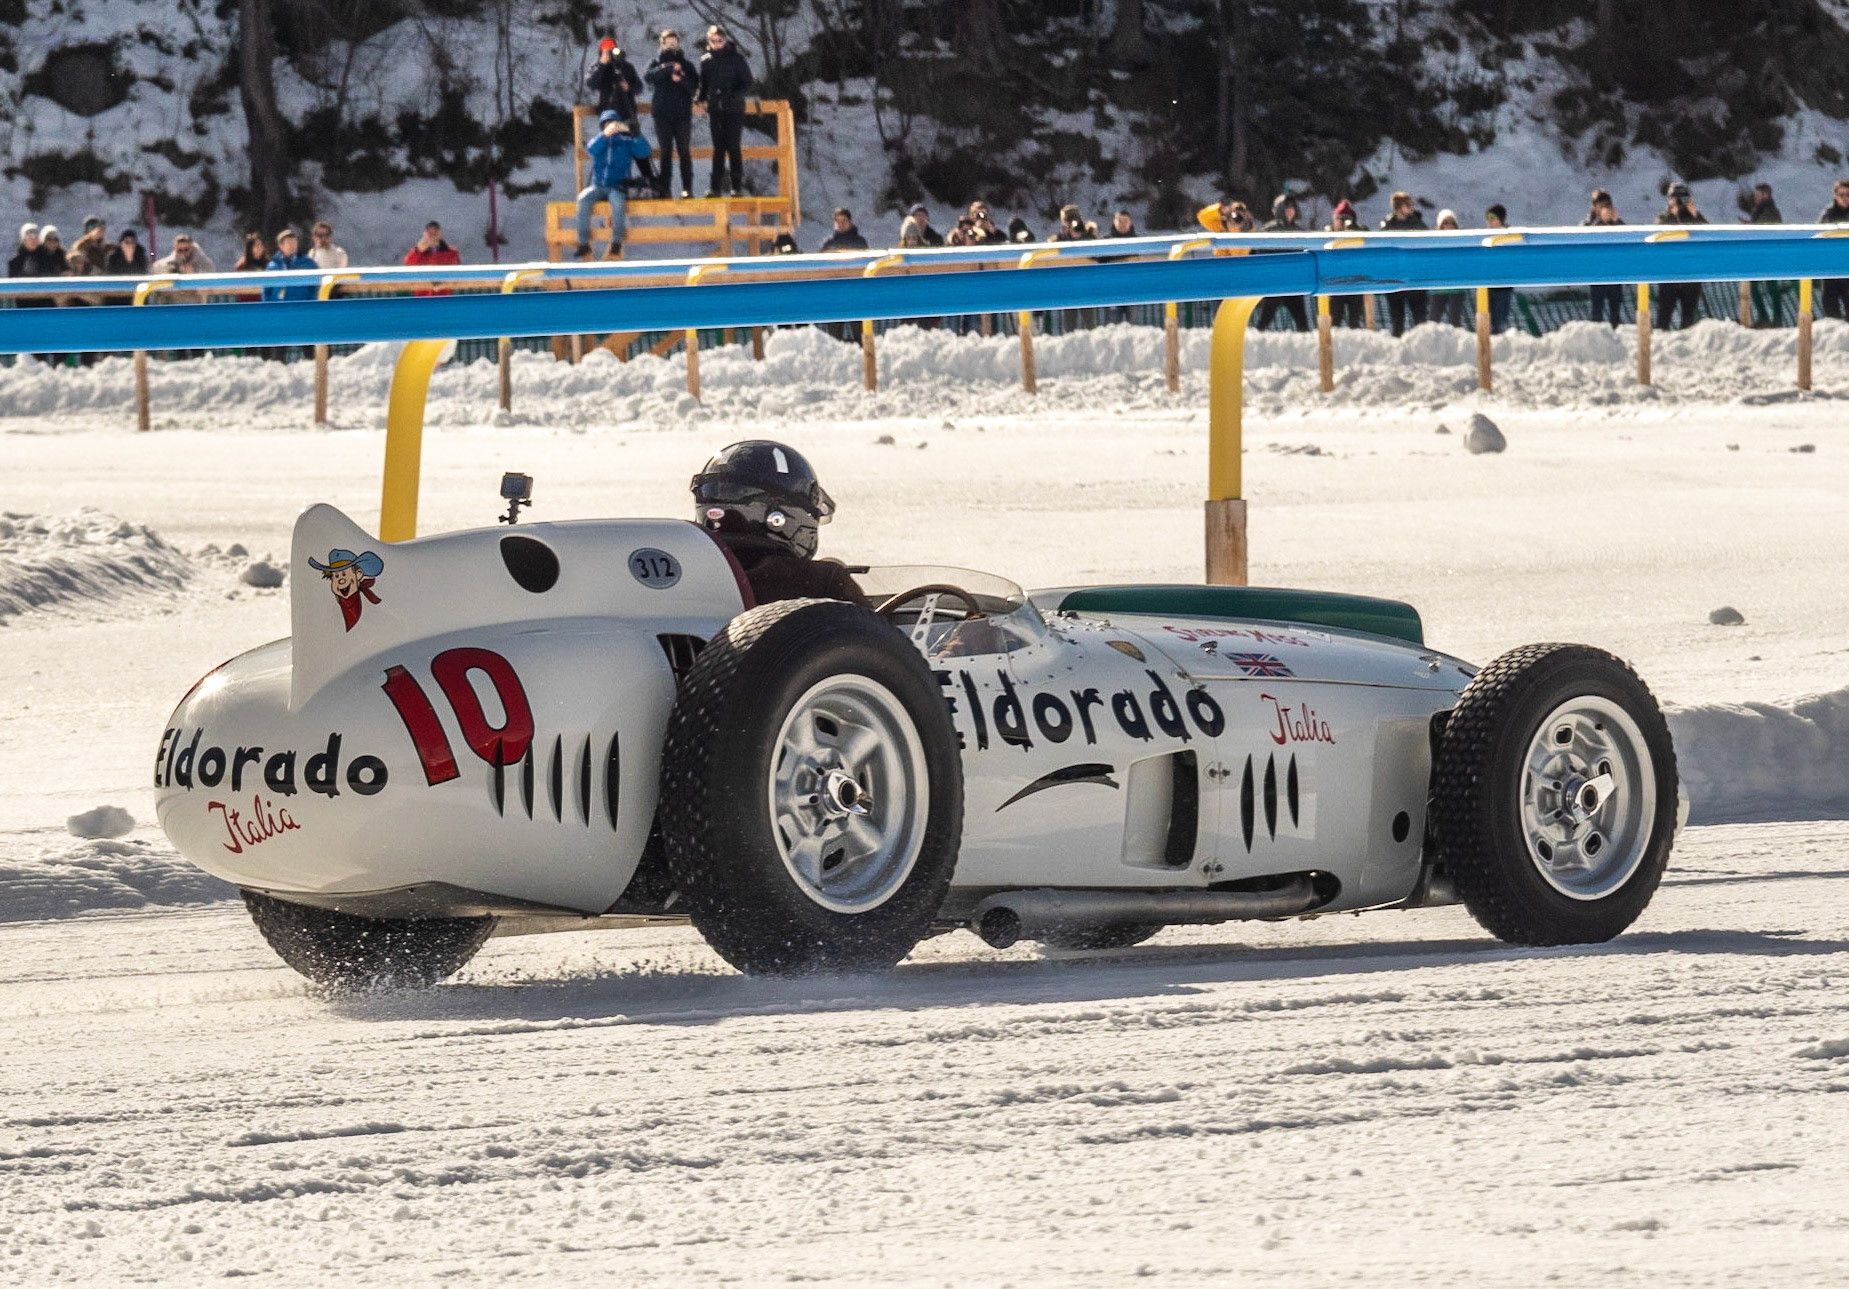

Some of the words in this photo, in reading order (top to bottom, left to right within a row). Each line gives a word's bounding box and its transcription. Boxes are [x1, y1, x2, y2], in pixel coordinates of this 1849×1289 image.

[637, 557, 675, 578] 312
[379, 647, 535, 787] 10
[1260, 692, 1336, 745] Italia
[155, 727, 389, 799] Eldorado
[208, 794, 301, 854] Italia
